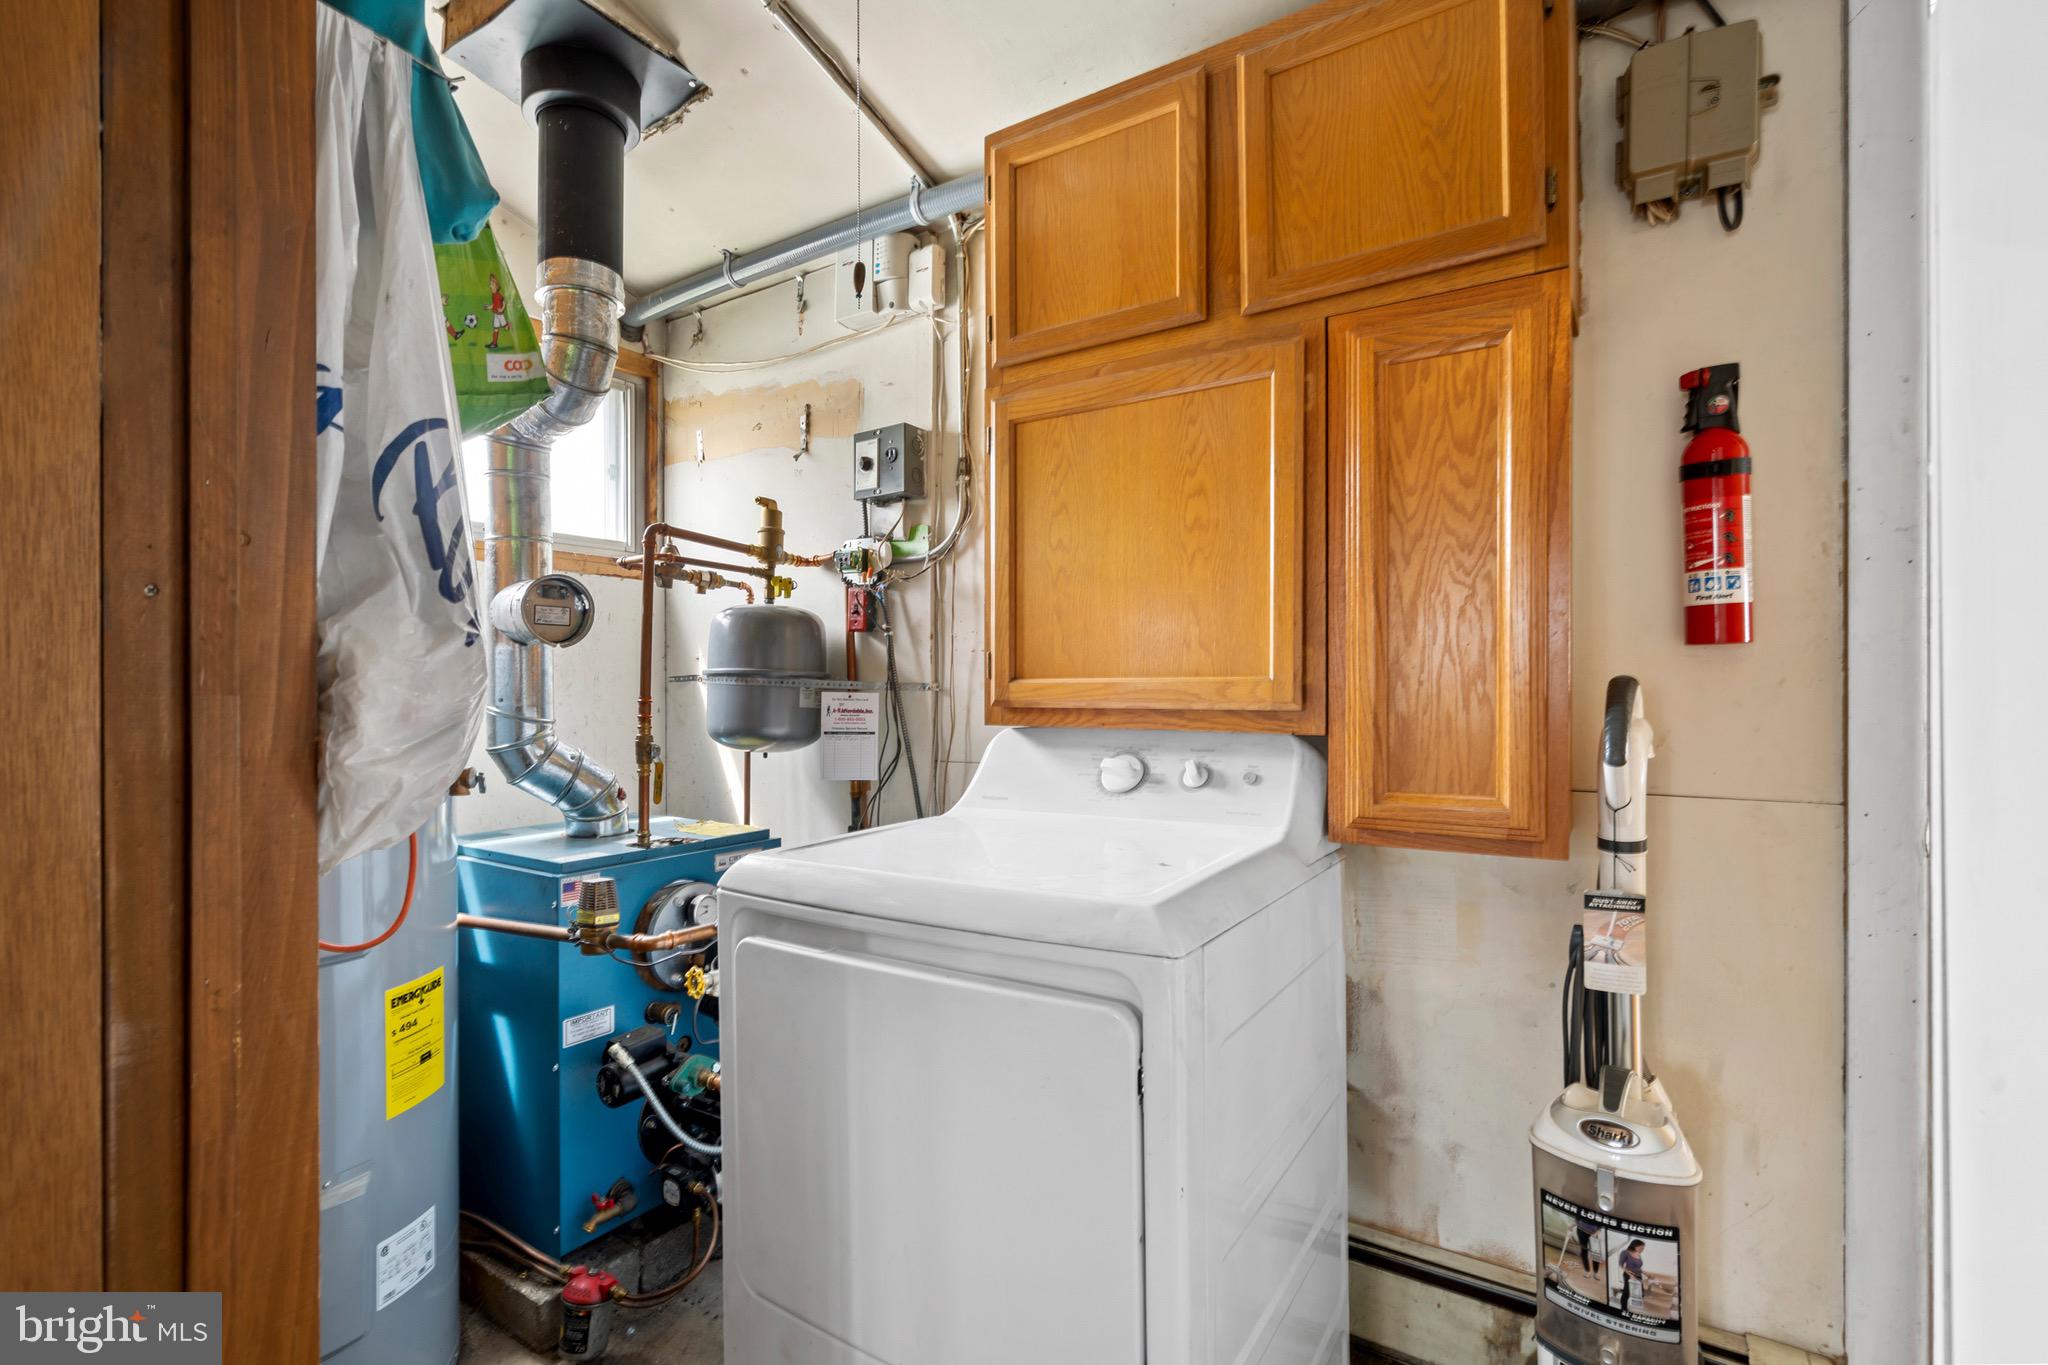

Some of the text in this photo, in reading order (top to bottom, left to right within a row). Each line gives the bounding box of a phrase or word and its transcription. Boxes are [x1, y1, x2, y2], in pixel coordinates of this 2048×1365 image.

[399, 1018, 418, 1033] 494
[571, 1010, 609, 1025] IMPORTANT
[1588, 1124, 1627, 1143] Shark
[1545, 1194, 1673, 1237] NEVER LOSES SUCTION
[1567, 1301, 1602, 1321] SWIVEL
[1606, 1318, 1657, 1337] STEERING
